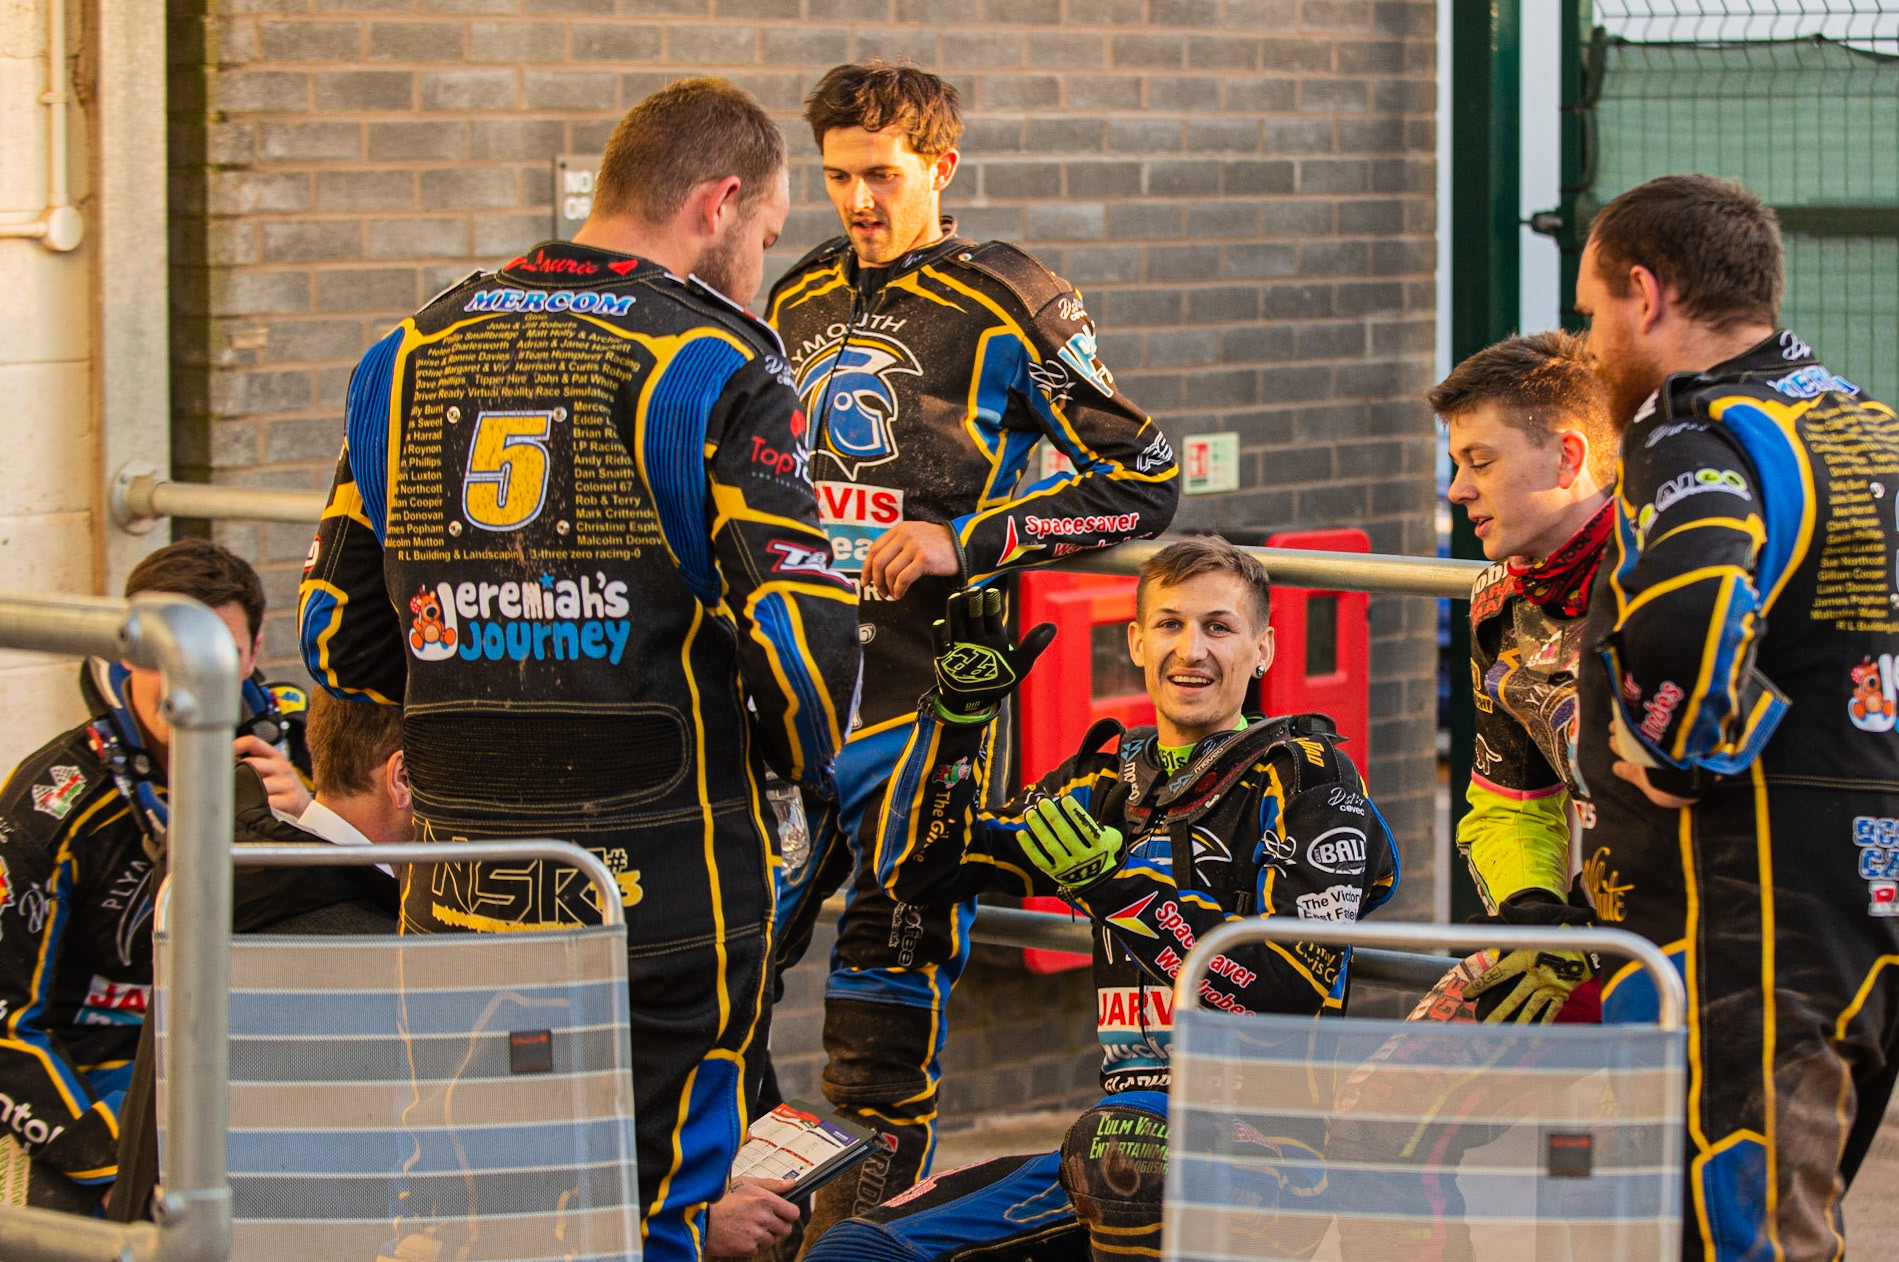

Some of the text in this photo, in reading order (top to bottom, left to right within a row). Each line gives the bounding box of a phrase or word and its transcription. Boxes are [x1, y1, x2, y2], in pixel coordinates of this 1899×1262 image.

[463, 288, 638, 316] MERCOM
[486, 322, 511, 330] John
[516, 340, 549, 350] Adrian
[478, 351, 511, 362] Davies
[605, 350, 642, 373] Racing
[515, 361, 557, 372] Harrison
[568, 360, 600, 372] Curtis
[535, 372, 560, 384] John
[467, 387, 499, 398] Virtual
[535, 386, 560, 398] Race
[424, 403, 444, 415] Bunt
[417, 418, 443, 428] Sweet
[573, 414, 603, 426] Eddie
[413, 430, 443, 441] Harrad
[572, 427, 602, 439] Brian
[408, 443, 442, 456] Roynon
[408, 457, 442, 469] Phillips
[573, 453, 602, 468] Andy
[411, 470, 443, 481] Luxton
[461, 410, 554, 531] 5
[574, 467, 635, 480] Dan Snaith
[400, 483, 443, 494] Northcott
[574, 481, 633, 493] Colonel 67
[409, 497, 443, 509] Cooper
[575, 494, 641, 508] Rob & Terry
[814, 486, 900, 524] VIS
[403, 510, 444, 521] Donovan
[575, 508, 656, 520] Mark Crittende
[406, 523, 444, 535] Popham
[576, 521, 627, 533] Christine
[1025, 513, 1140, 538] Spacesaver
[412, 537, 445, 548] Mutton
[577, 535, 664, 546] Malcolm Donov
[398, 550, 405, 561] R
[413, 549, 451, 562] Building
[453, 549, 461, 561] &
[570, 550, 593, 561] zero
[409, 571, 630, 662] Jeremiah's
[459, 620, 632, 666] Journey
[934, 790, 951, 818] The
[1302, 898, 1329, 910] The
[90, 984, 148, 1012] JA
[1098, 991, 1174, 1026] JARV
